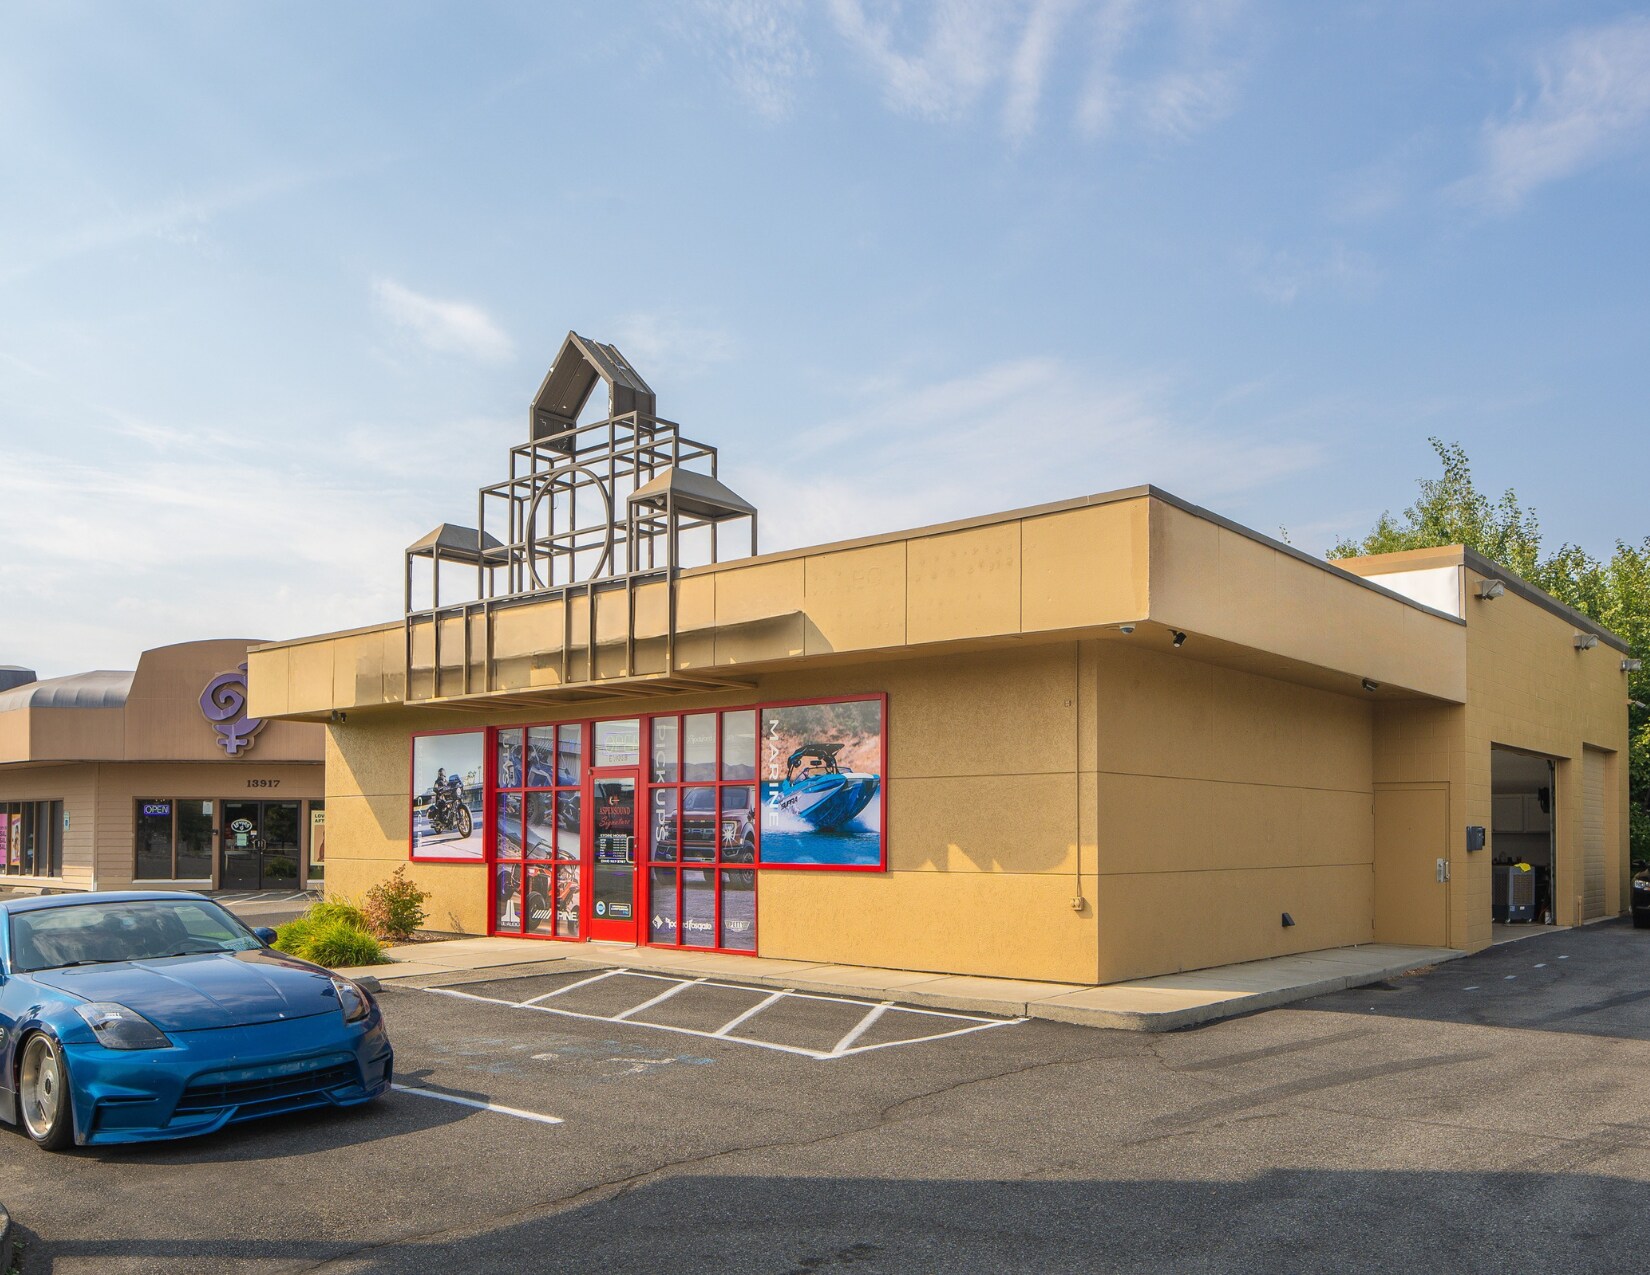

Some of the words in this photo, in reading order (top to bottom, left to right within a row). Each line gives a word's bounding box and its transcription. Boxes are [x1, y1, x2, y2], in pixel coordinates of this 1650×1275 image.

[769, 720, 779, 827] MARINE
[247, 779, 280, 788] 13917
[655, 725, 666, 842] PICKUPS
[146, 805, 169, 814] OPEN
[599, 816, 630, 830] Signature
